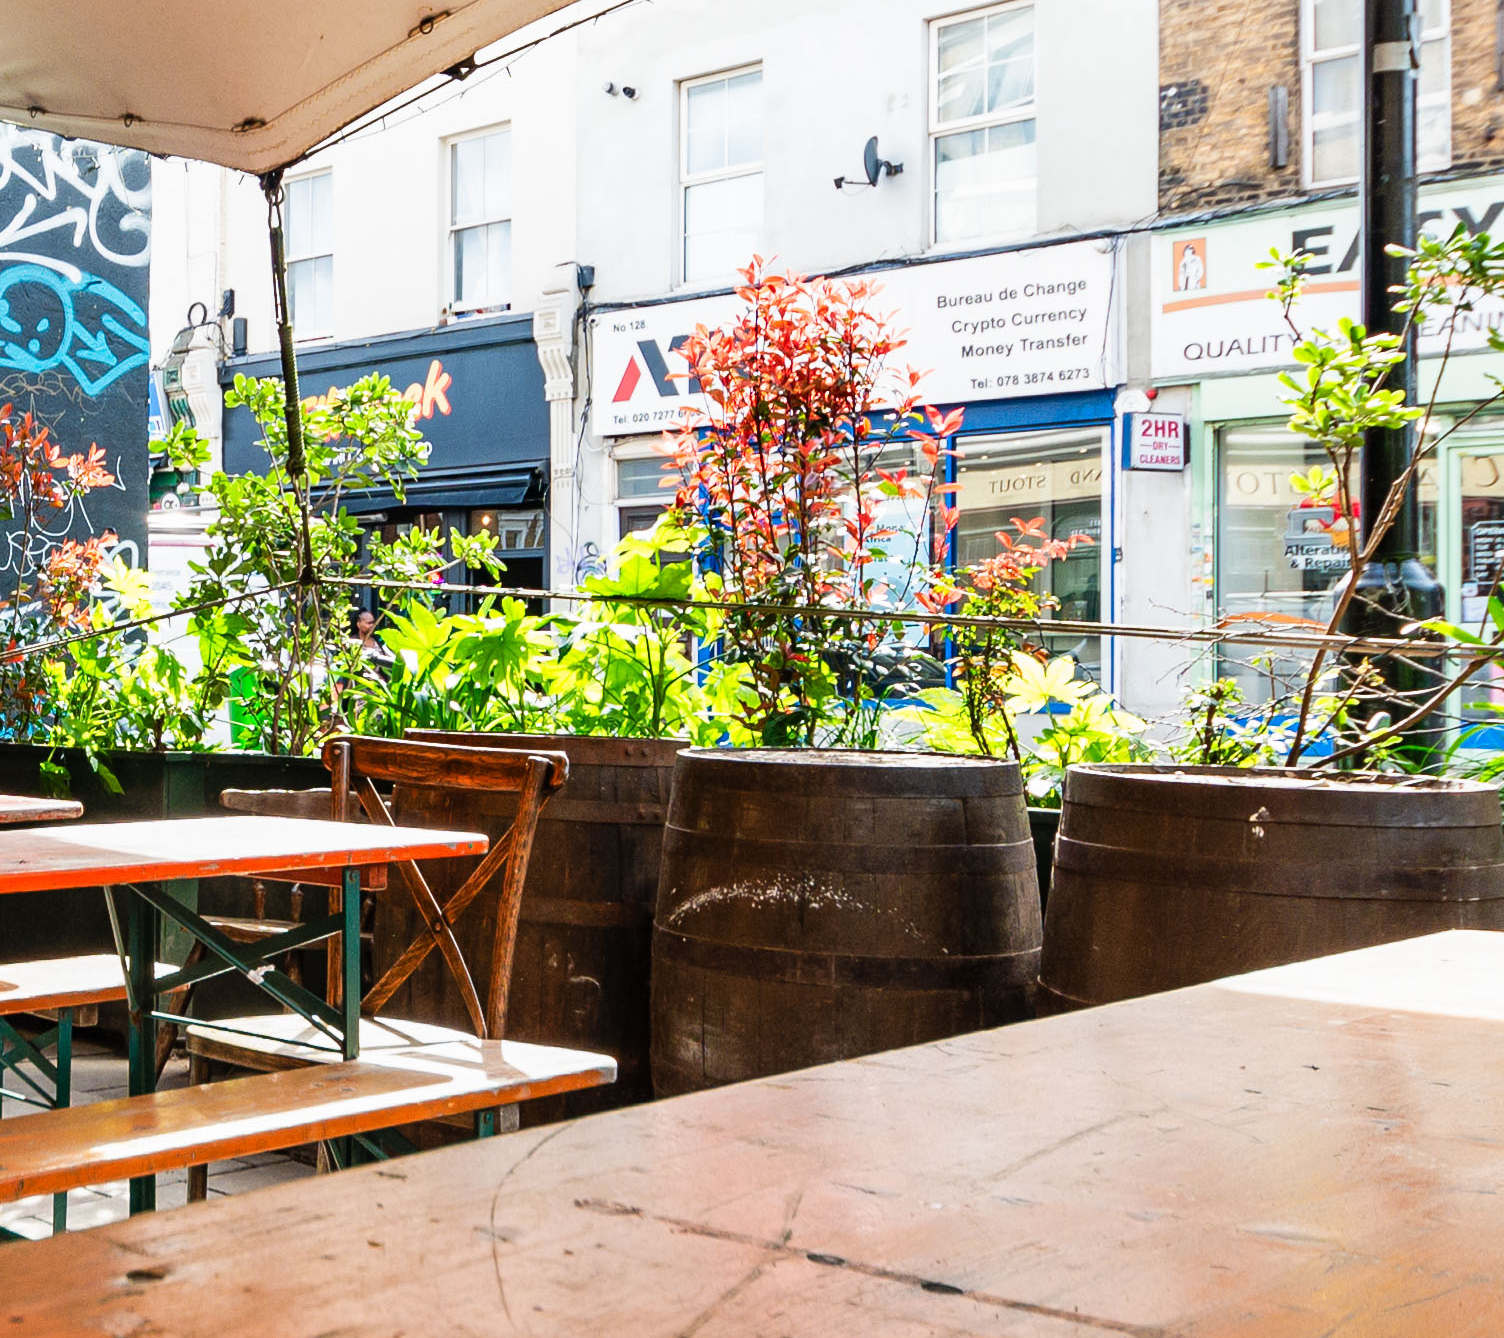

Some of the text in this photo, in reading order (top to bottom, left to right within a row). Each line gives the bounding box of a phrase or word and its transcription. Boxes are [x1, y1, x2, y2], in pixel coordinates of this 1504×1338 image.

[936, 279, 1087, 309] Bureau de Change
[613, 320, 646, 332] No 128
[951, 308, 1087, 335] Crypto Currency
[961, 333, 1088, 358] Money Transfer
[1183, 332, 1303, 361] QUALITY
[970, 368, 1090, 390] Tel: 078 3874 6273
[632, 412, 649, 422] 020
[653, 409, 675, 420] 7277
[1142, 419, 1179, 439] 2HR
[1152, 441, 1169, 451] DRY
[1139, 454, 1181, 465] CLEANERS
[1305, 557, 1351, 570] Repair
